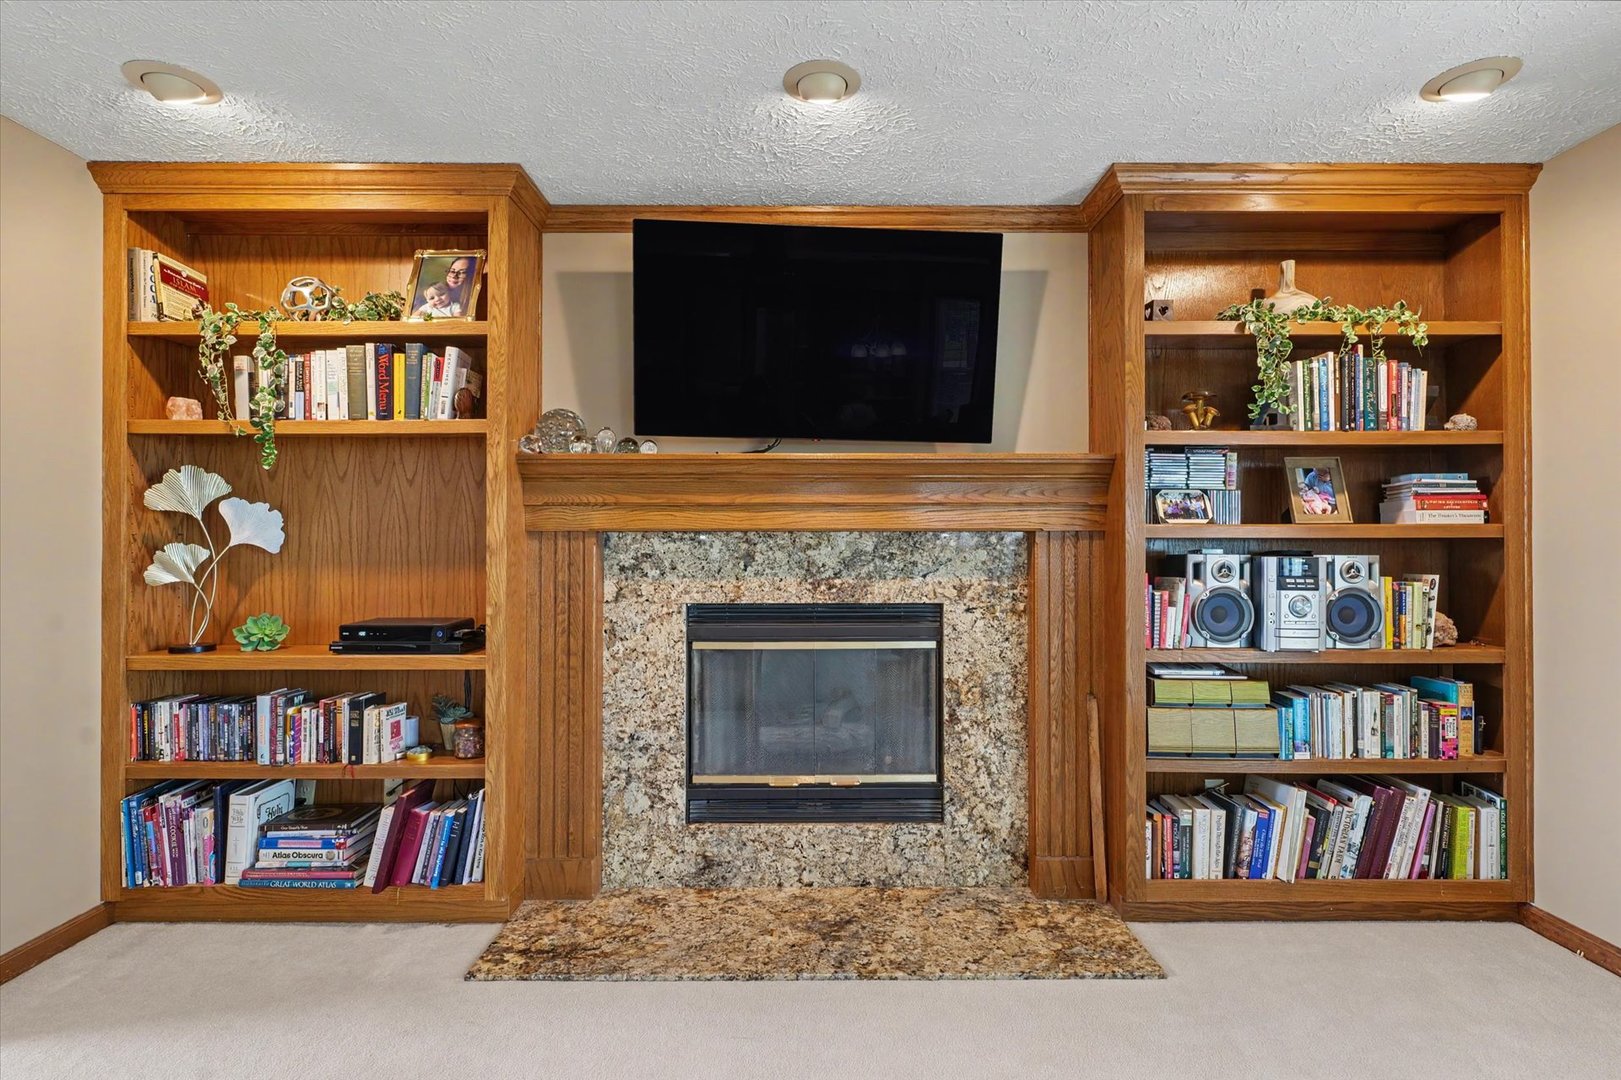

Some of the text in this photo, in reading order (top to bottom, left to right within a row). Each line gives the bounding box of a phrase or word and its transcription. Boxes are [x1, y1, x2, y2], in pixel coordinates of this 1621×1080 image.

[379, 354, 391, 410] Word Menu
[1339, 810, 1353, 844] VICTORIAN
[272, 851, 324, 859] Atlas Obscura
[1334, 845, 1346, 864] FARM
[270, 880, 290, 888] GREAT
[292, 880, 317, 888] WORLD
[318, 880, 337, 888] ATLAS
